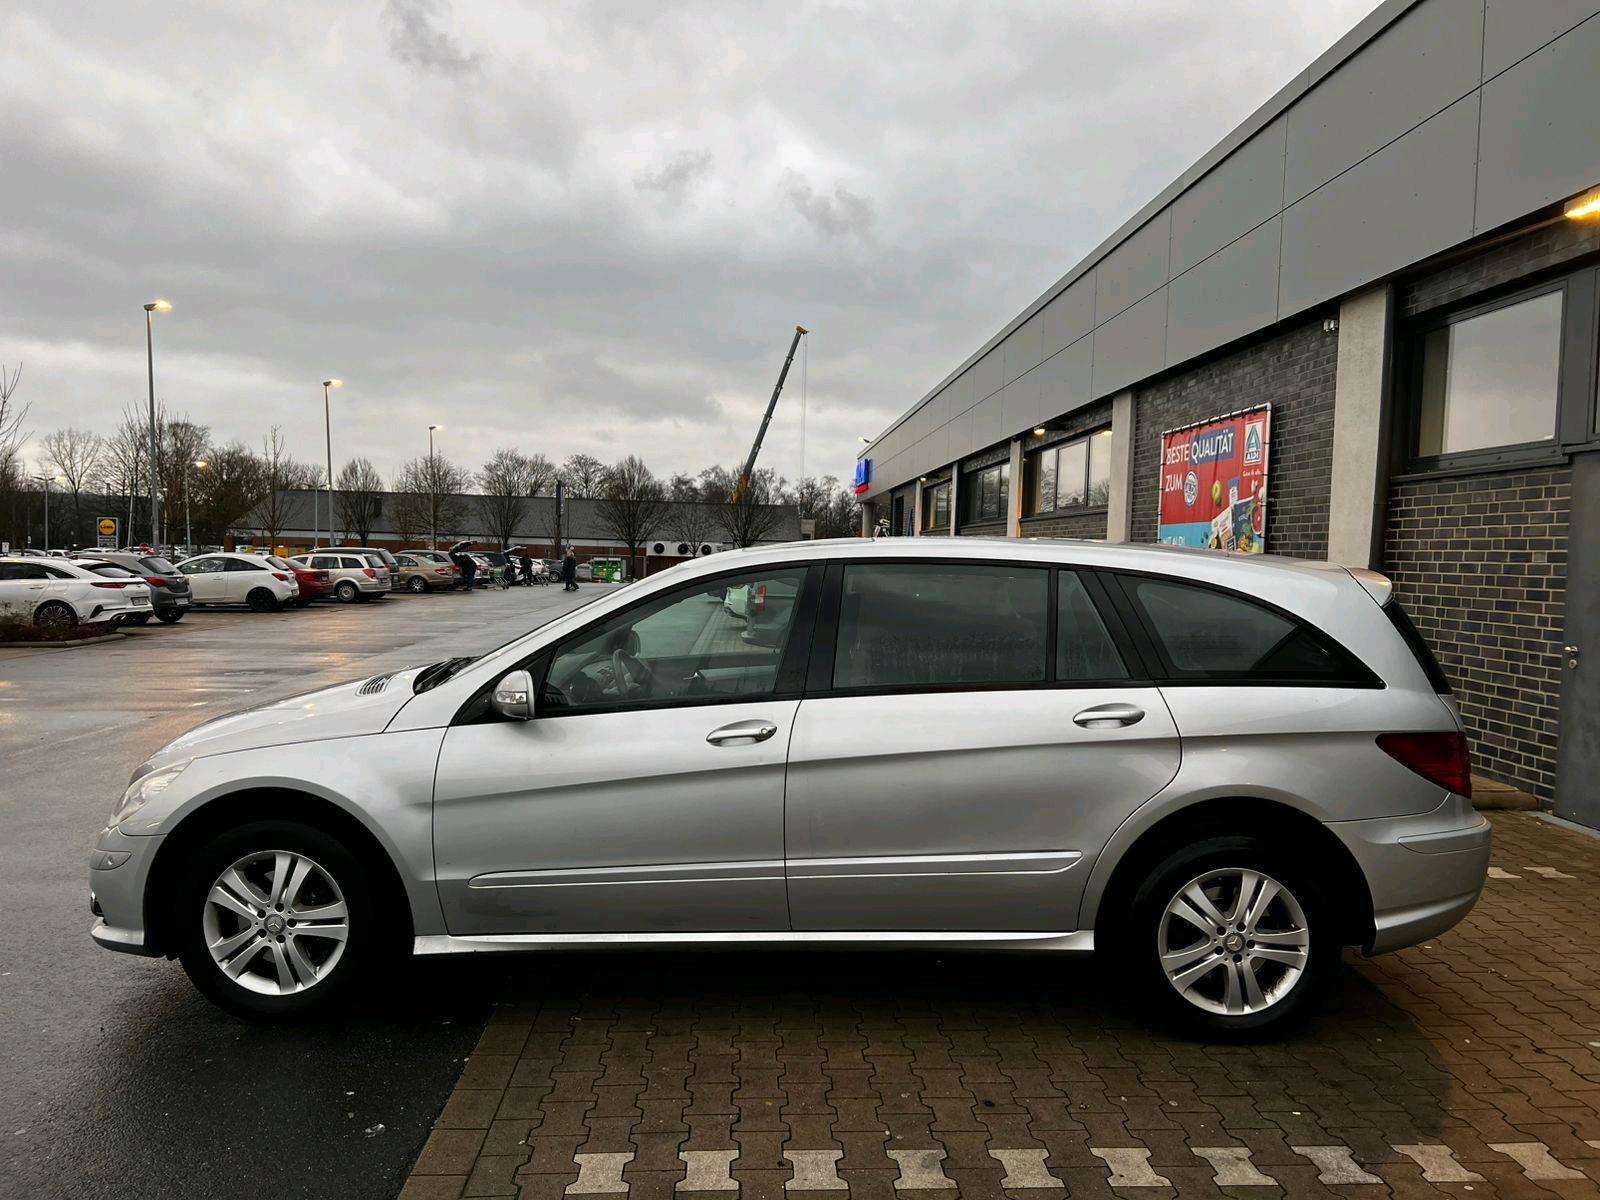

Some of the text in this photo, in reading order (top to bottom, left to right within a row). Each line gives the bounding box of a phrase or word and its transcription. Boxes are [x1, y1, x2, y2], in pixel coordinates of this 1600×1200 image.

[1166, 429, 1234, 465] BESTE QUALITÄT
[1246, 452, 1259, 460] ALDI
[1165, 473, 1183, 492] ZUM
